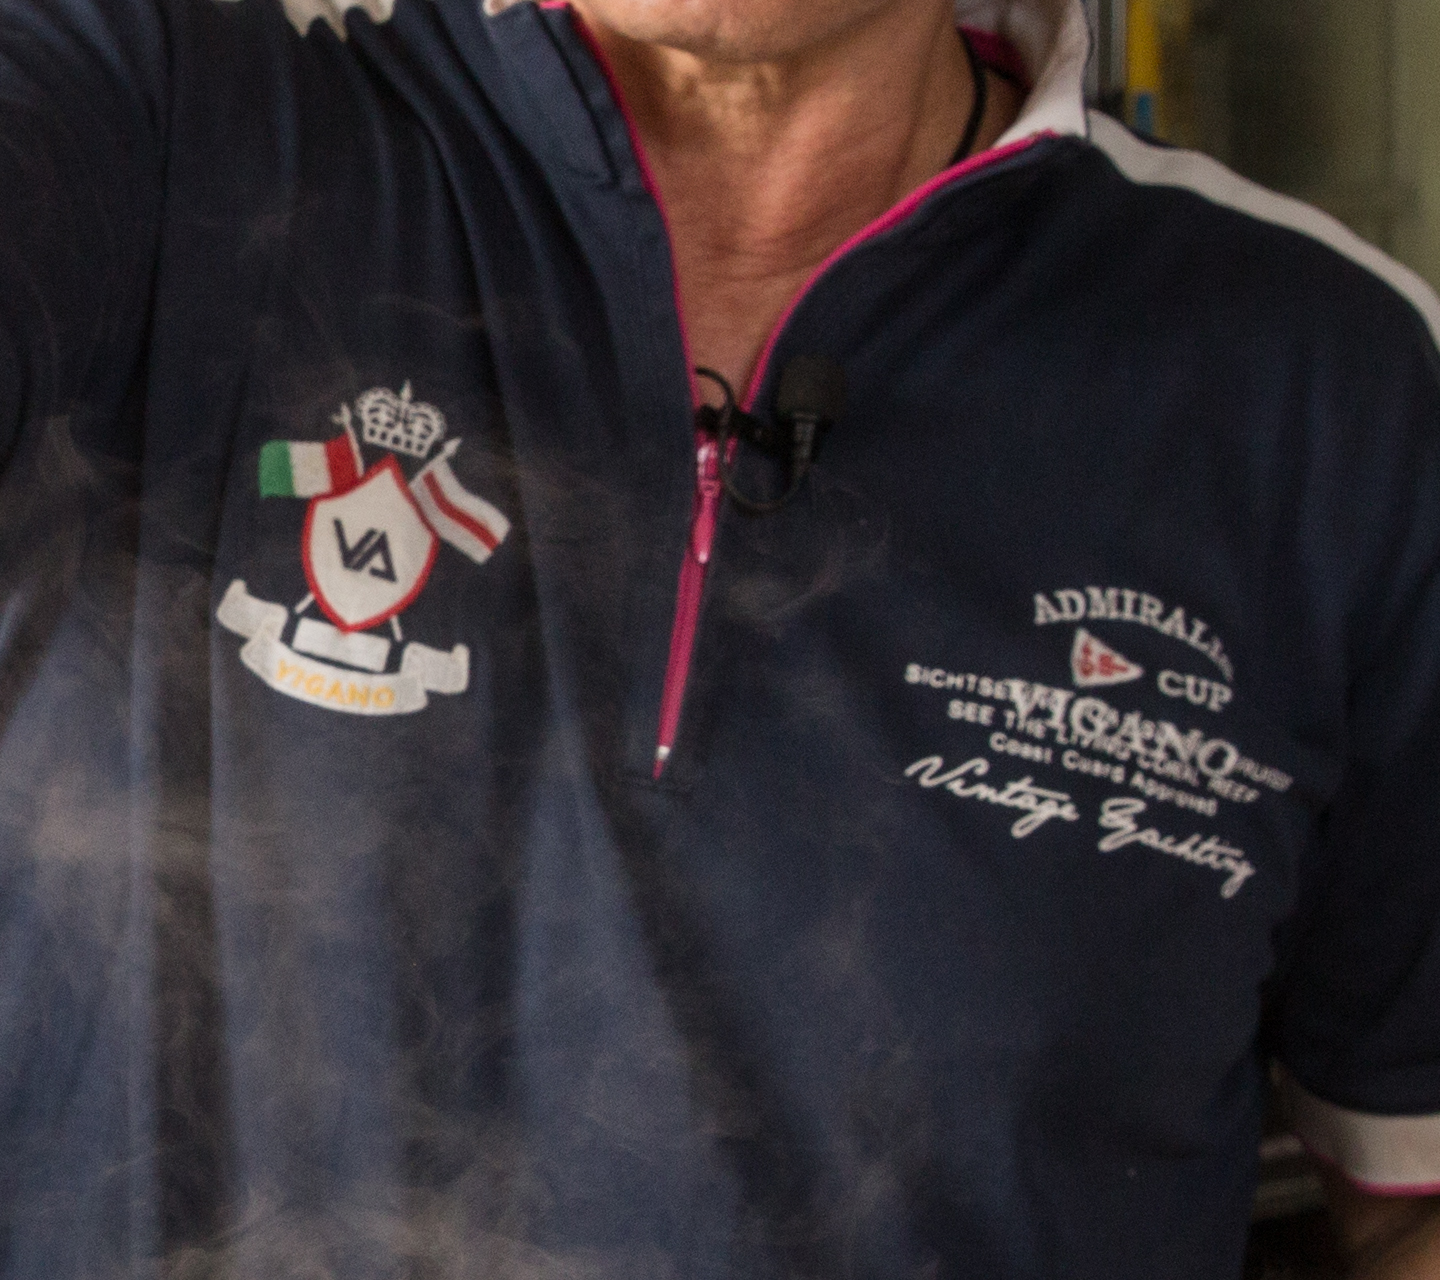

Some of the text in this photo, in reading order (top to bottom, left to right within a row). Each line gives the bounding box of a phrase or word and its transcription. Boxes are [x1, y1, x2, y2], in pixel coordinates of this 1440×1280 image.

[948, 698, 995, 727] SEE
[1157, 669, 1233, 713] CUP
[904, 754, 1080, 839] Vintage
